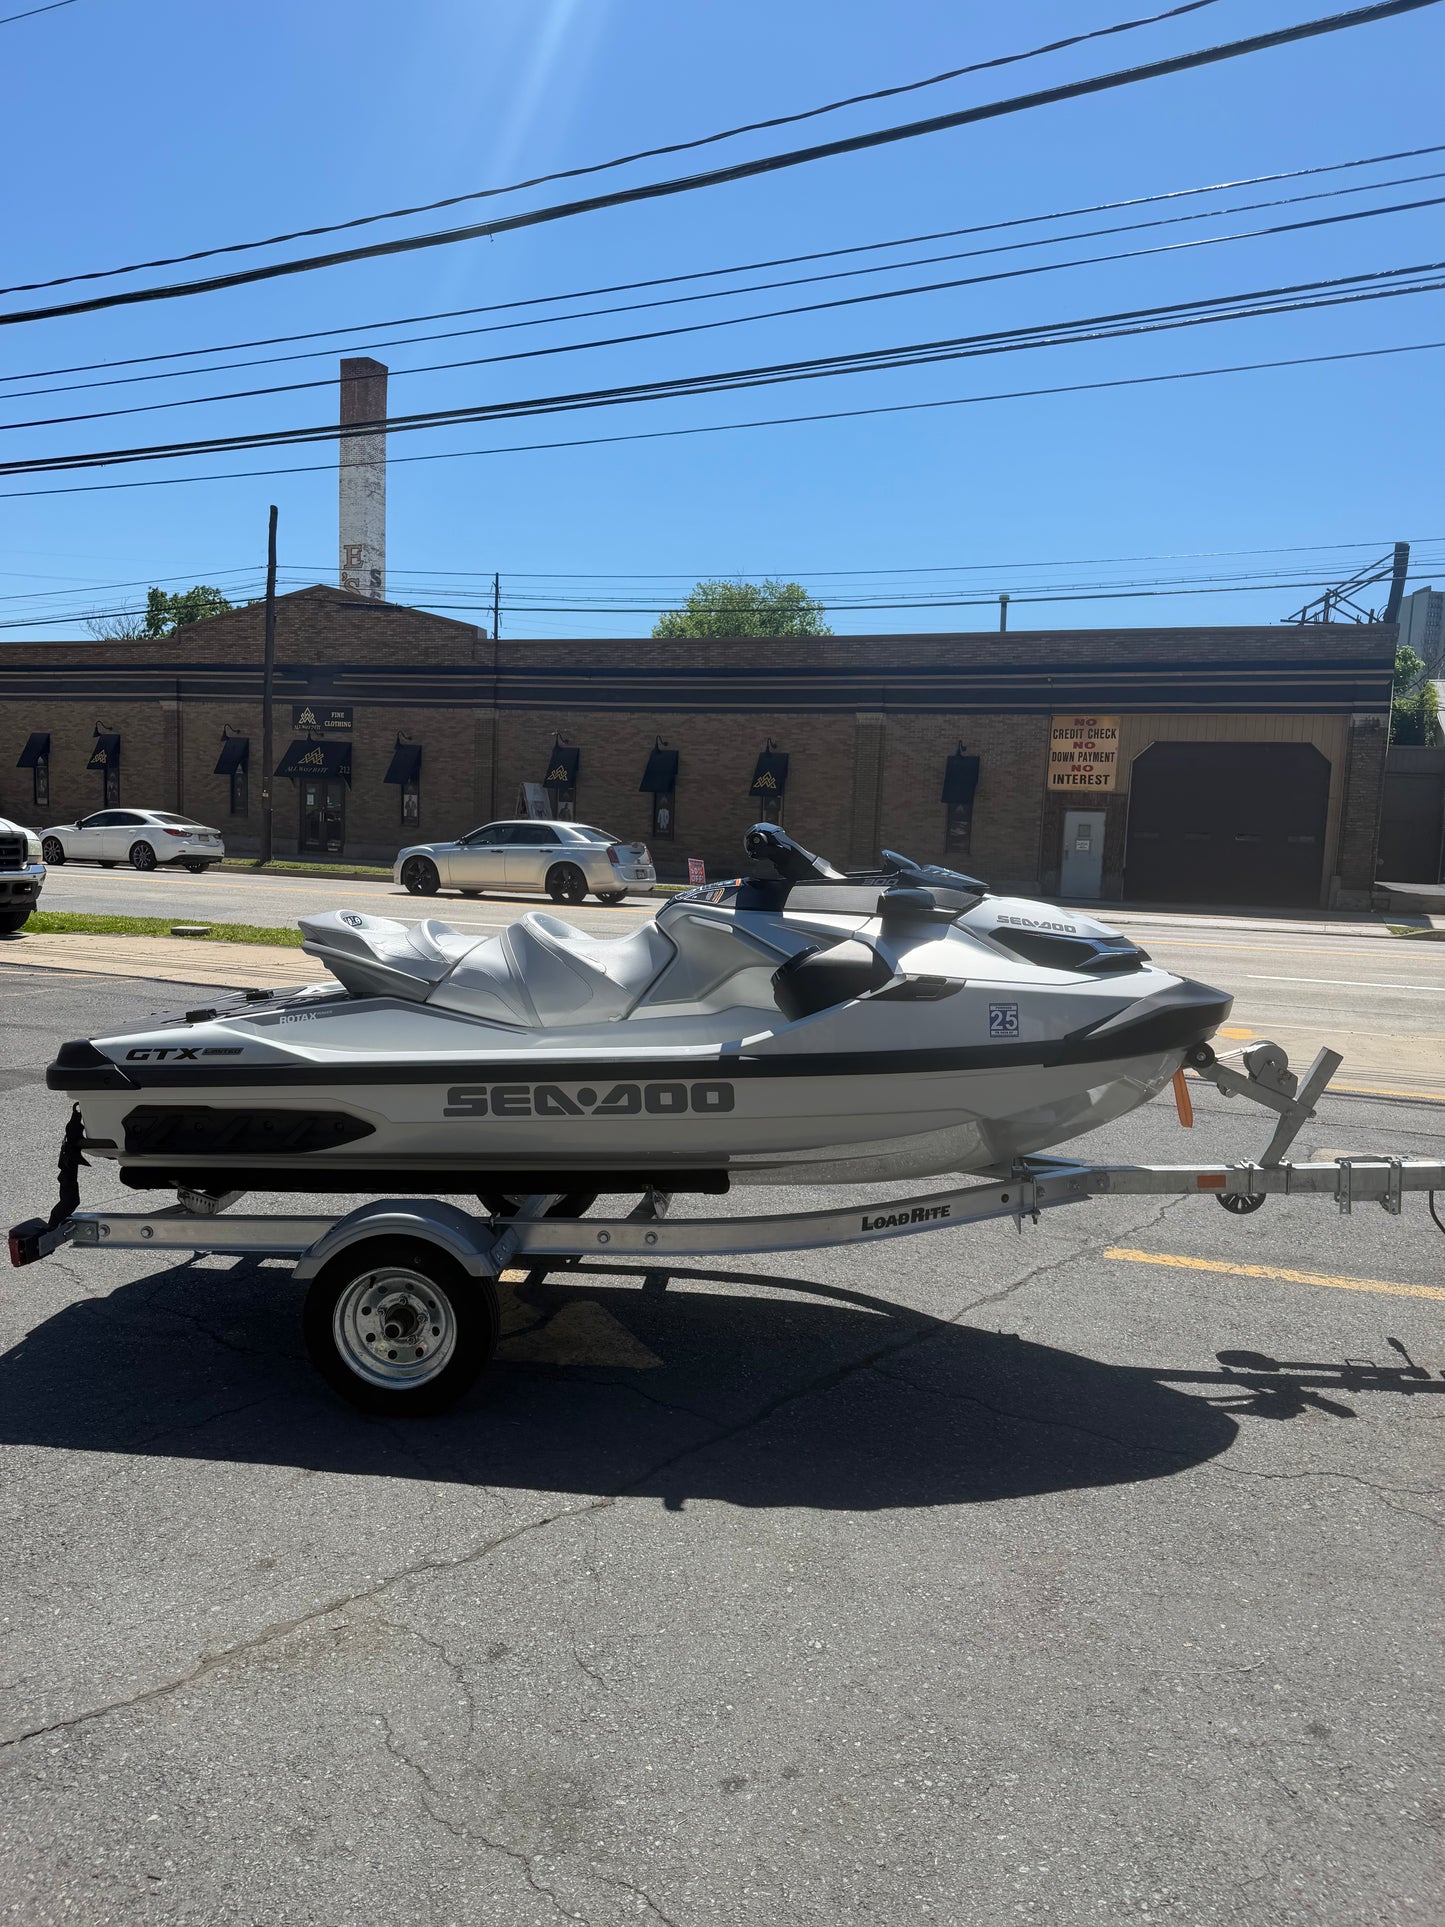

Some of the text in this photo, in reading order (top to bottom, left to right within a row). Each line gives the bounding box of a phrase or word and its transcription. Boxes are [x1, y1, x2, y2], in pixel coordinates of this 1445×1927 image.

[331, 711, 344, 719] FINE
[1074, 718, 1097, 726] NO
[1053, 728, 1116, 739] CREDIT CHECK
[1073, 741, 1096, 749] NO
[1052, 751, 1115, 762] DOWN PAYMENT
[1071, 764, 1094, 772] NO
[1053, 774, 1110, 785] INTEREST
[279, 1012, 317, 1025] ROTAX
[990, 1010, 1018, 1030] 25
[125, 1047, 204, 1061] GTX
